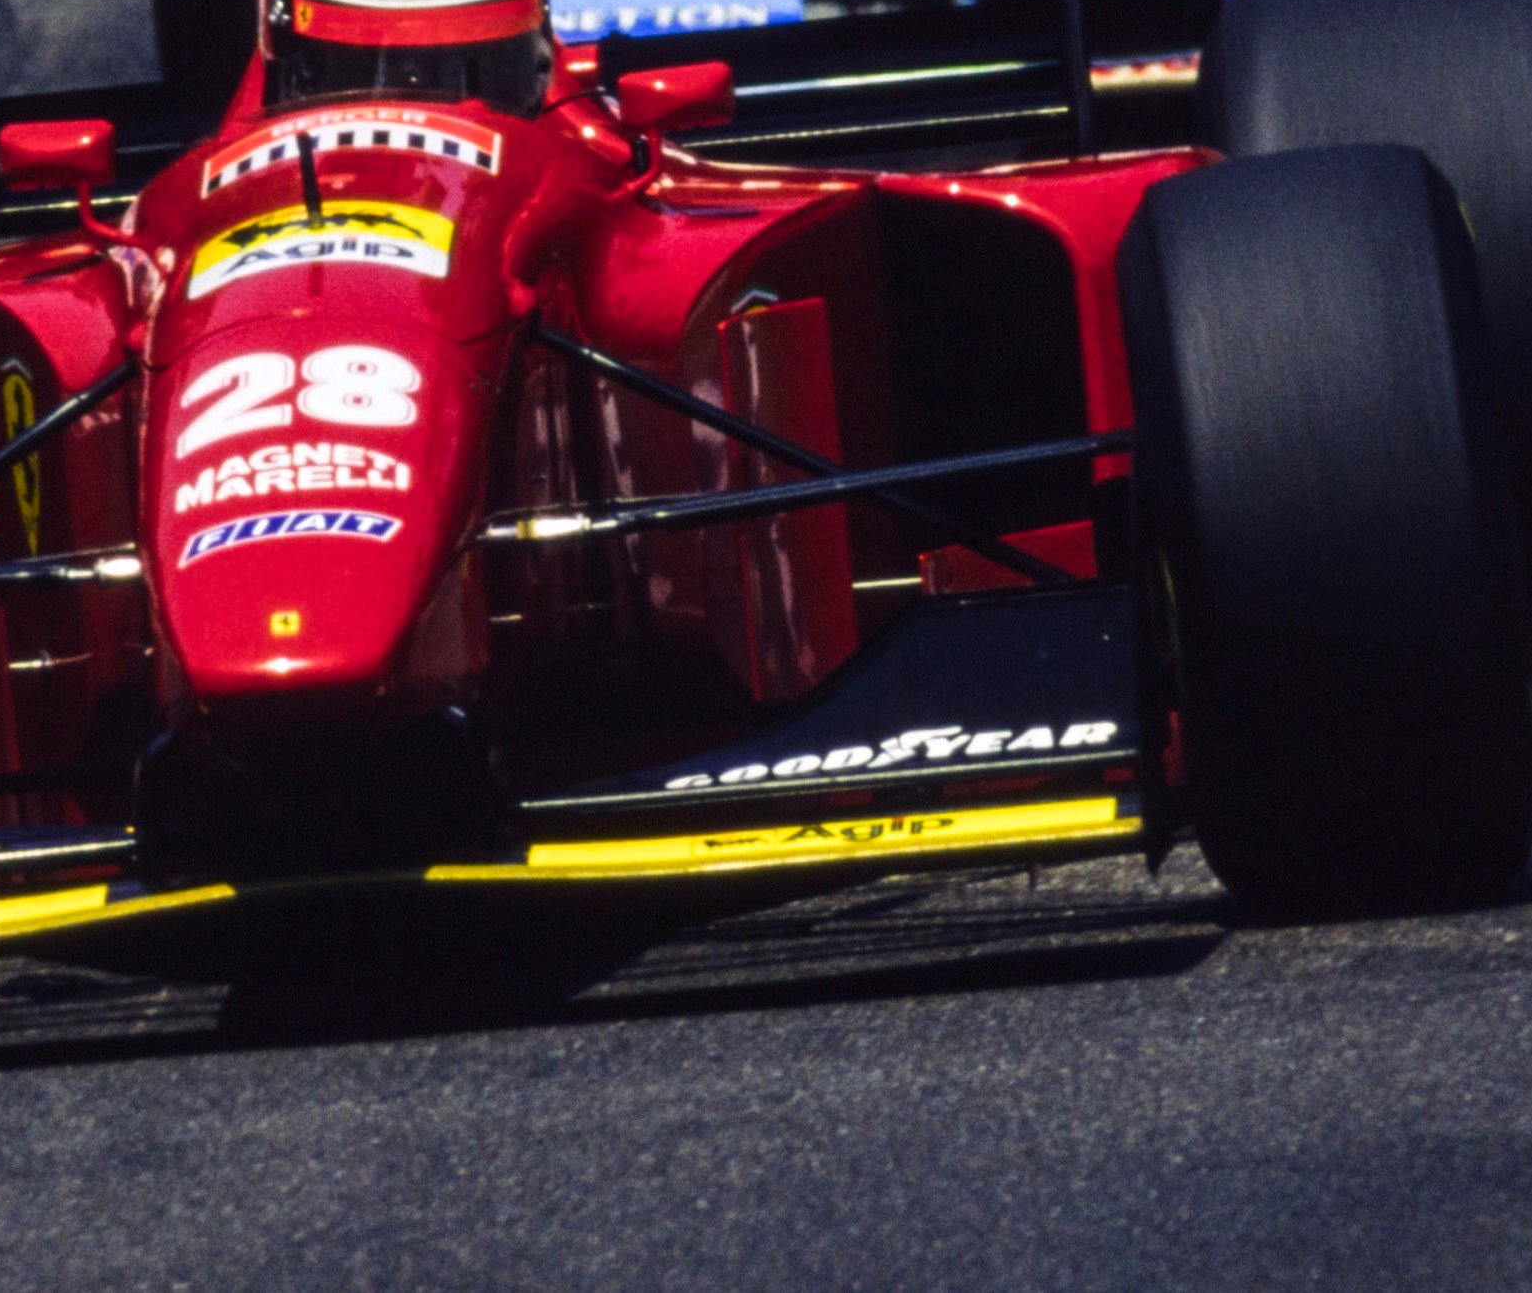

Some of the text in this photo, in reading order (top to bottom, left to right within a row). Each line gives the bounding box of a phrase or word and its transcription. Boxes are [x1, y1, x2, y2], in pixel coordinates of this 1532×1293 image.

[270, 108, 428, 138] BERGER
[222, 235, 416, 277] Agip
[176, 344, 422, 461] 28
[175, 442, 410, 501] MAGNETI
[175, 462, 410, 513] MARELLI
[194, 512, 387, 554] FIAT
[665, 721, 1118, 790] GOODYEAR
[783, 814, 954, 844] Agip
